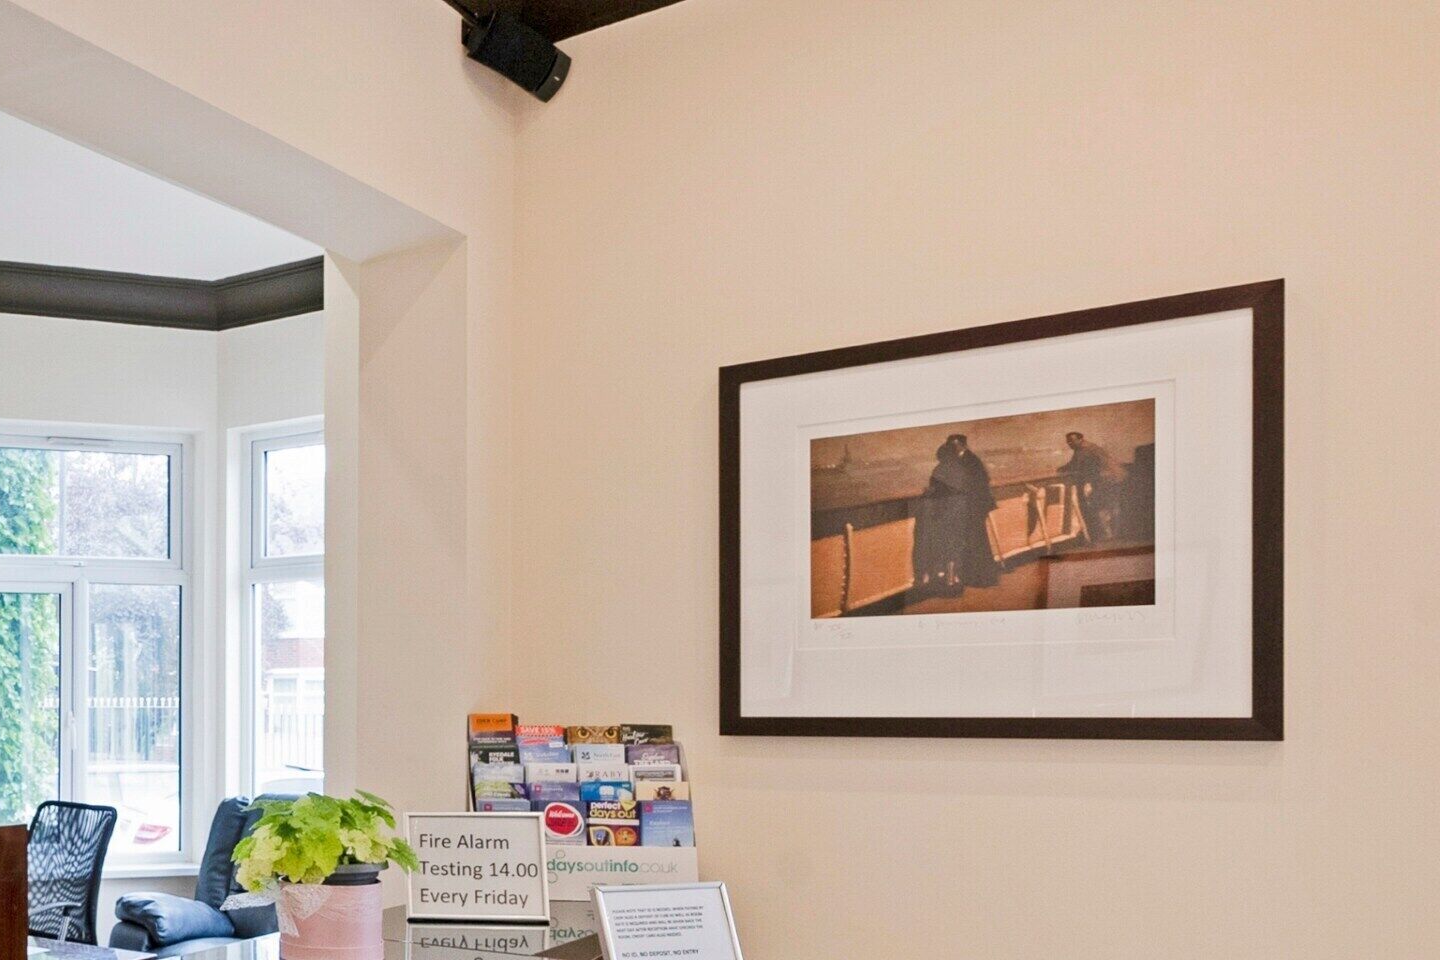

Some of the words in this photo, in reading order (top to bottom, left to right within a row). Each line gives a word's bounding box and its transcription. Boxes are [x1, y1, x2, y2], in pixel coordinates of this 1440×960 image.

[589, 808, 616, 819] days
[617, 809, 637, 819] out
[590, 802, 621, 812] perfect
[419, 834, 452, 849] Fire
[457, 834, 510, 850] Alarm
[419, 860, 483, 880] Testing
[489, 862, 539, 878] 14.00
[420, 888, 468, 907] Every
[474, 889, 529, 909] Friday
